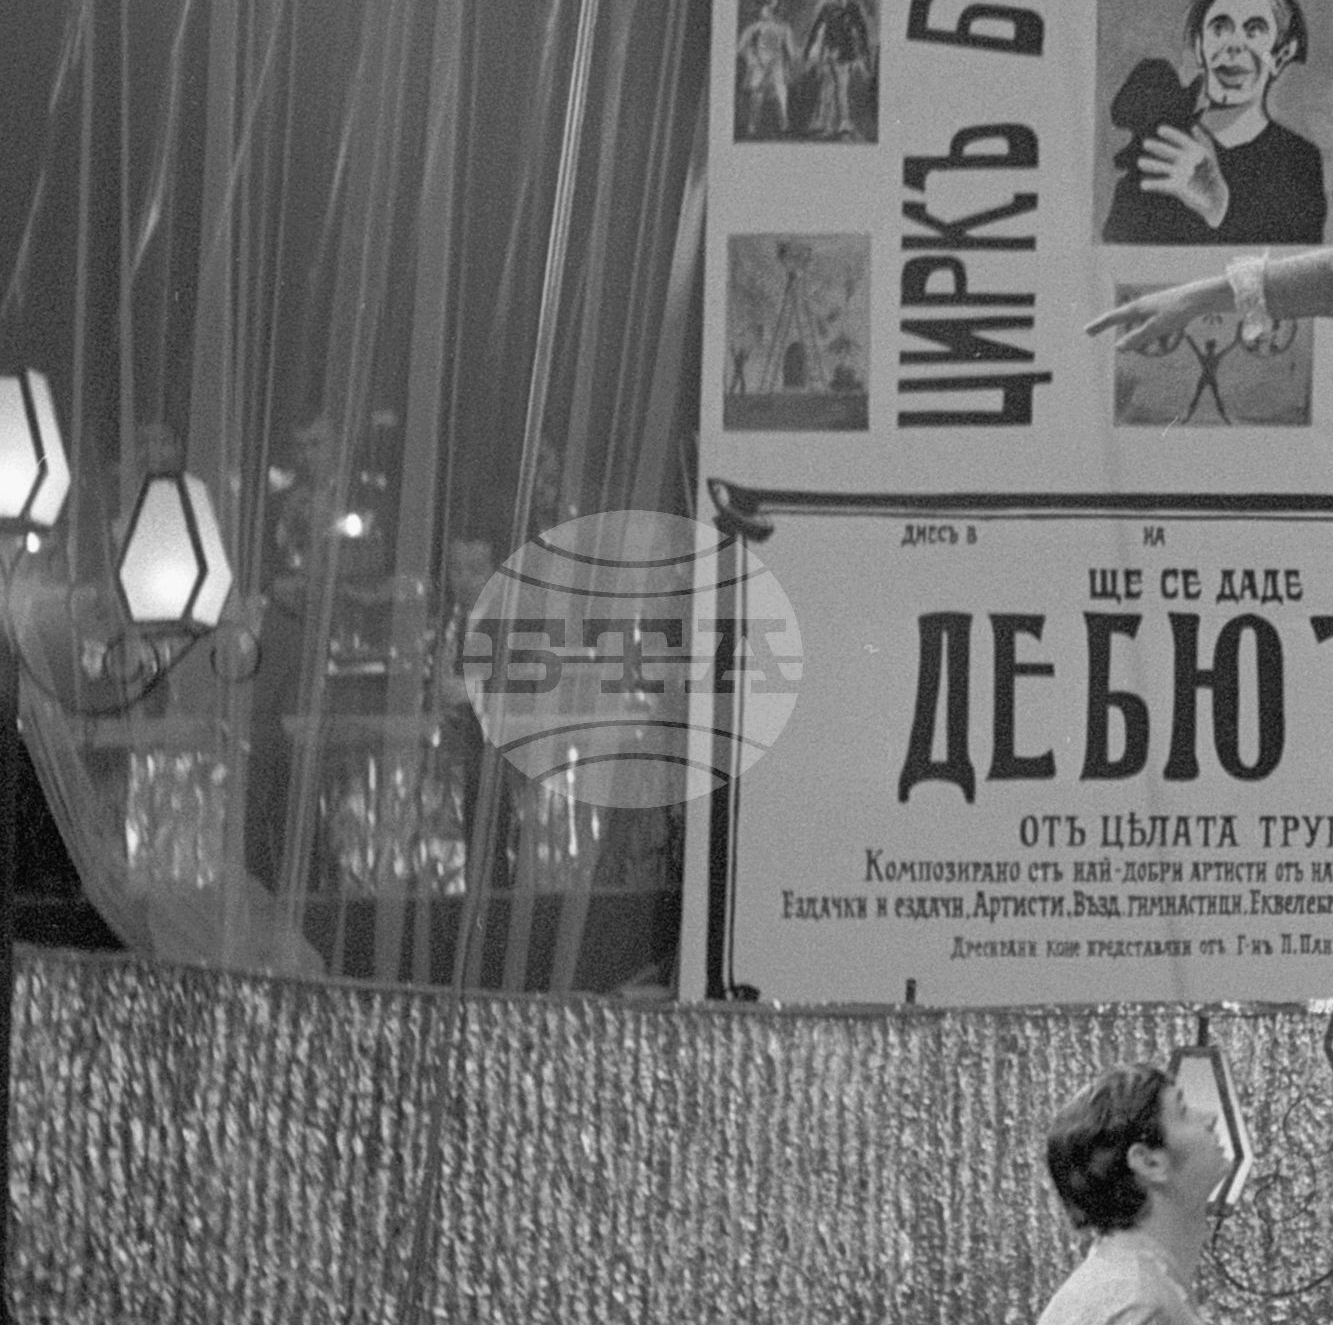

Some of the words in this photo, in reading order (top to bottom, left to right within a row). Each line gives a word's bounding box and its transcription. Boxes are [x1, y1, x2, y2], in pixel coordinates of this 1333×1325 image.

[896, 122, 1053, 429] ЦИРКЪ
[1143, 526, 1166, 547] НА
[1089, 568, 1143, 605] ЩЕ
[1160, 568, 1203, 600] СЕ
[1216, 569, 1304, 604] ДАДЕ
[1020, 814, 1087, 848] ОТЪ
